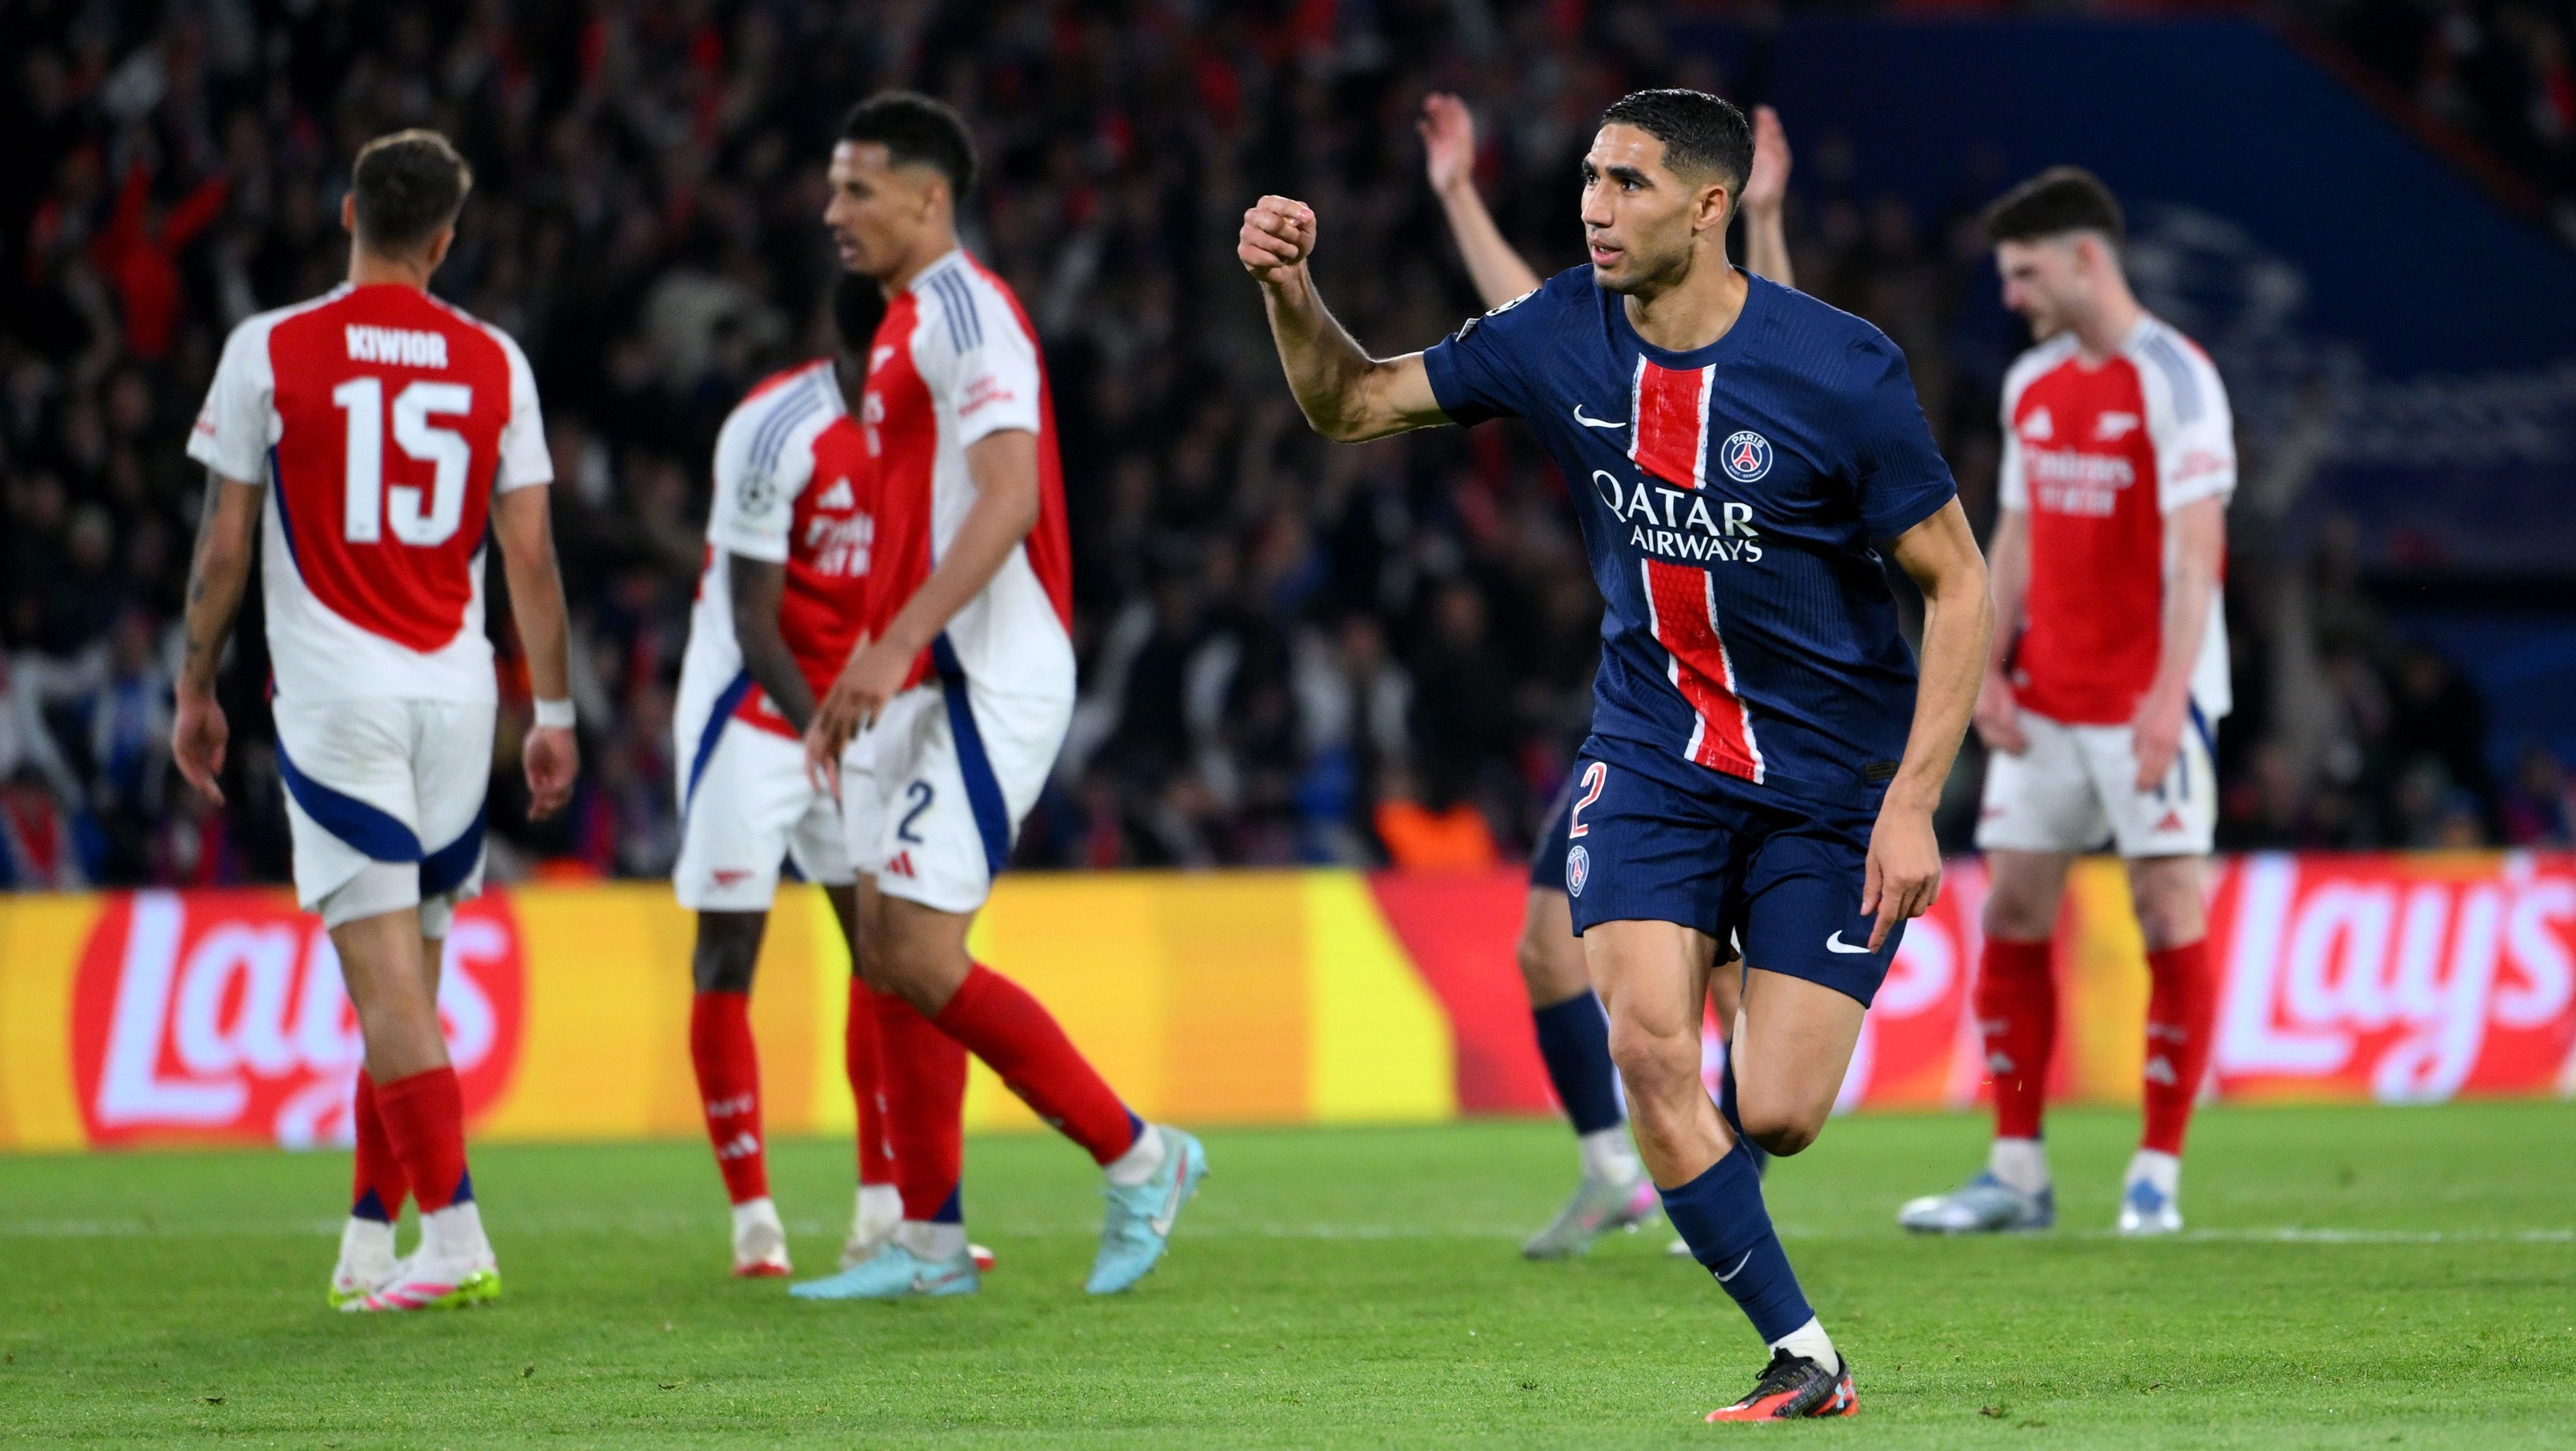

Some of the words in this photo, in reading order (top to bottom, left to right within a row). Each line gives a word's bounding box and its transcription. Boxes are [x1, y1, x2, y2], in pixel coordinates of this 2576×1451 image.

[345, 324, 448, 369] KIWIOR
[333, 377, 472, 547] 15
[1731, 434, 1765, 448] PARIS
[1592, 470, 1759, 537] QATAR
[1630, 525, 1763, 563] AIRWAYS
[897, 780, 934, 844] 2
[1570, 761, 1607, 839] 2
[2217, 851, 2576, 1104] Lay's
[95, 887, 507, 1152] Las
